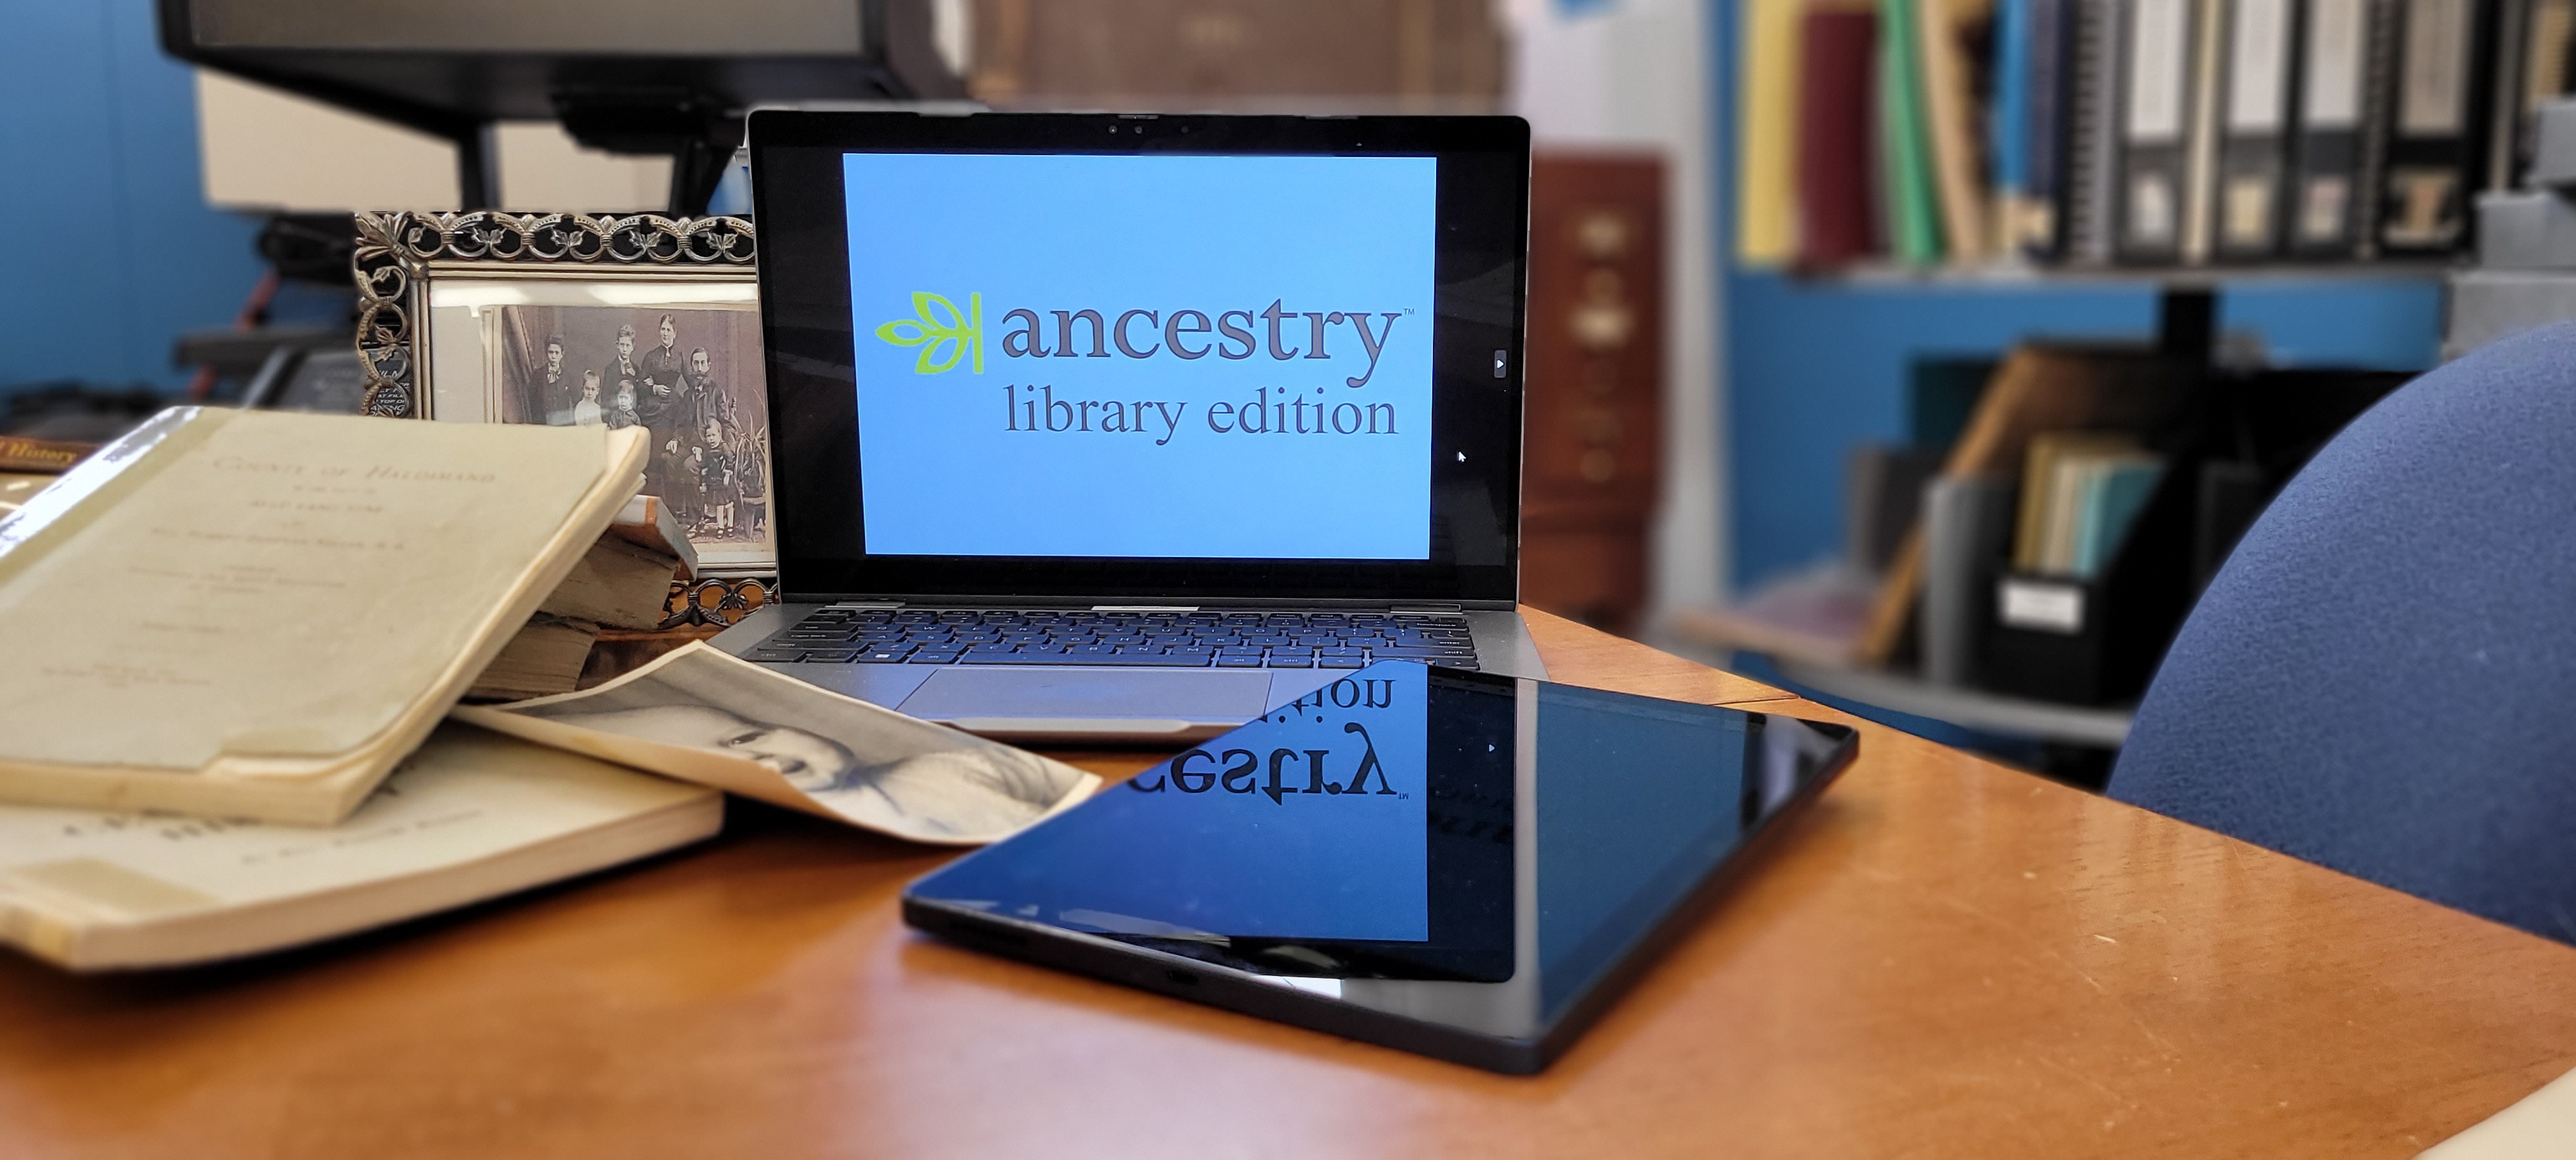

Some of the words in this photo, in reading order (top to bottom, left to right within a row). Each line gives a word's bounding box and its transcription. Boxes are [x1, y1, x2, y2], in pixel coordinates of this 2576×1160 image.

[1002, 298, 1402, 388] ancestry
[1003, 385, 1188, 446] library
[1208, 386, 1399, 436] edition
